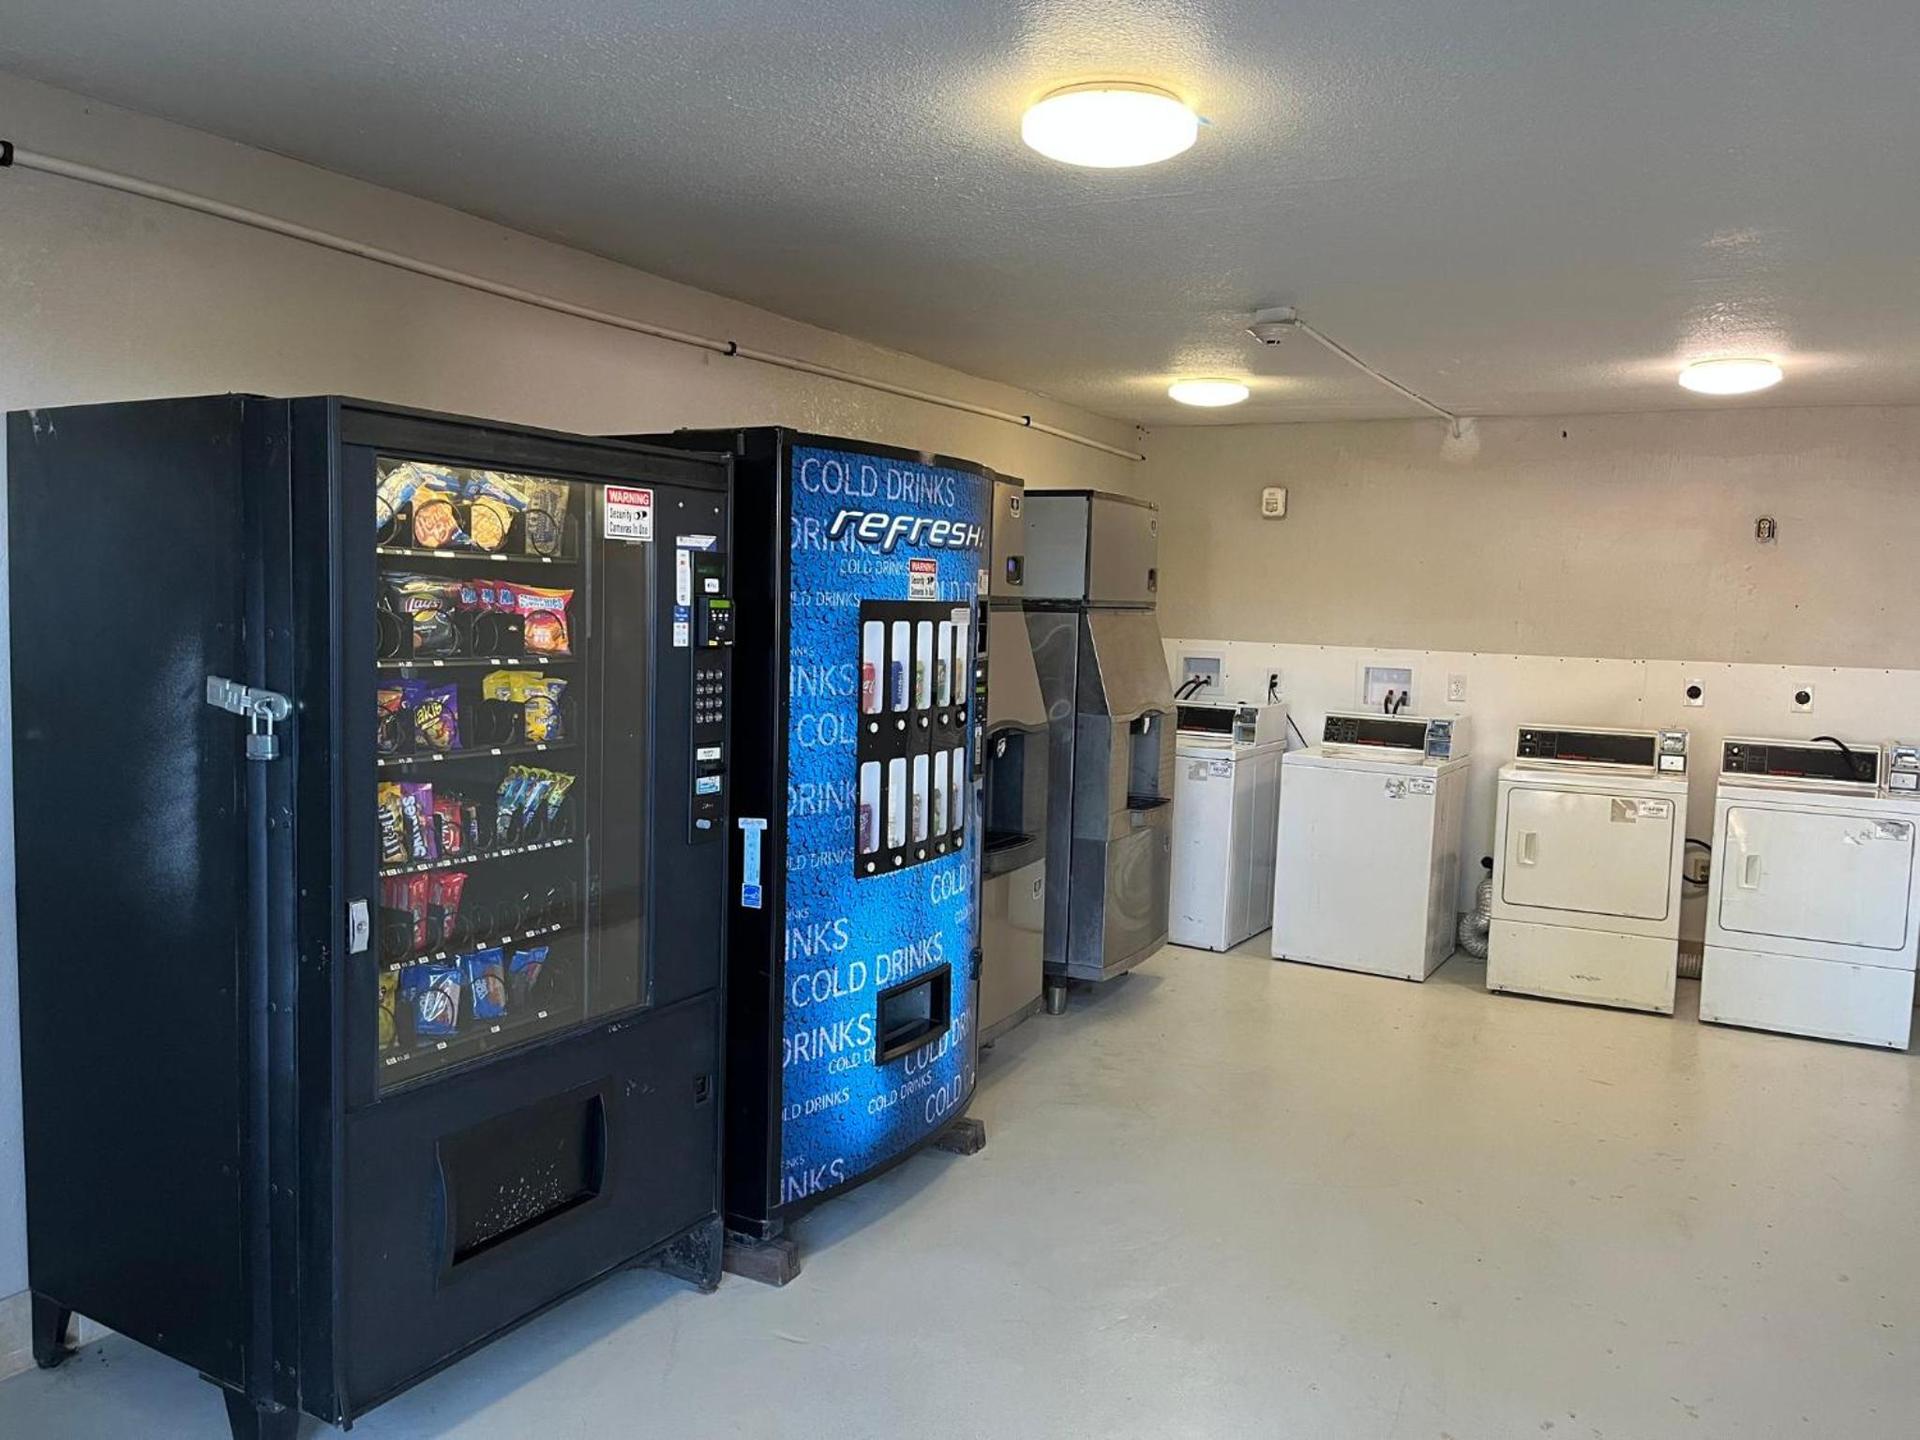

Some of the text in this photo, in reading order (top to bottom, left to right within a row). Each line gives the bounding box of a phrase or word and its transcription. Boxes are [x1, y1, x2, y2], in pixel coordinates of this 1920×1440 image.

[608, 489, 650, 505] WARNING
[800, 458, 956, 507] COLD DRINKS
[415, 703, 442, 723] akis
[930, 863, 967, 905] COLD
[792, 932, 943, 1008] COLD DRINKS
[805, 1087, 850, 1116] DRINKS
[868, 1091, 898, 1115] COLD
[899, 1071, 931, 1101] DRINKS
[925, 1075, 961, 1124] COLD
